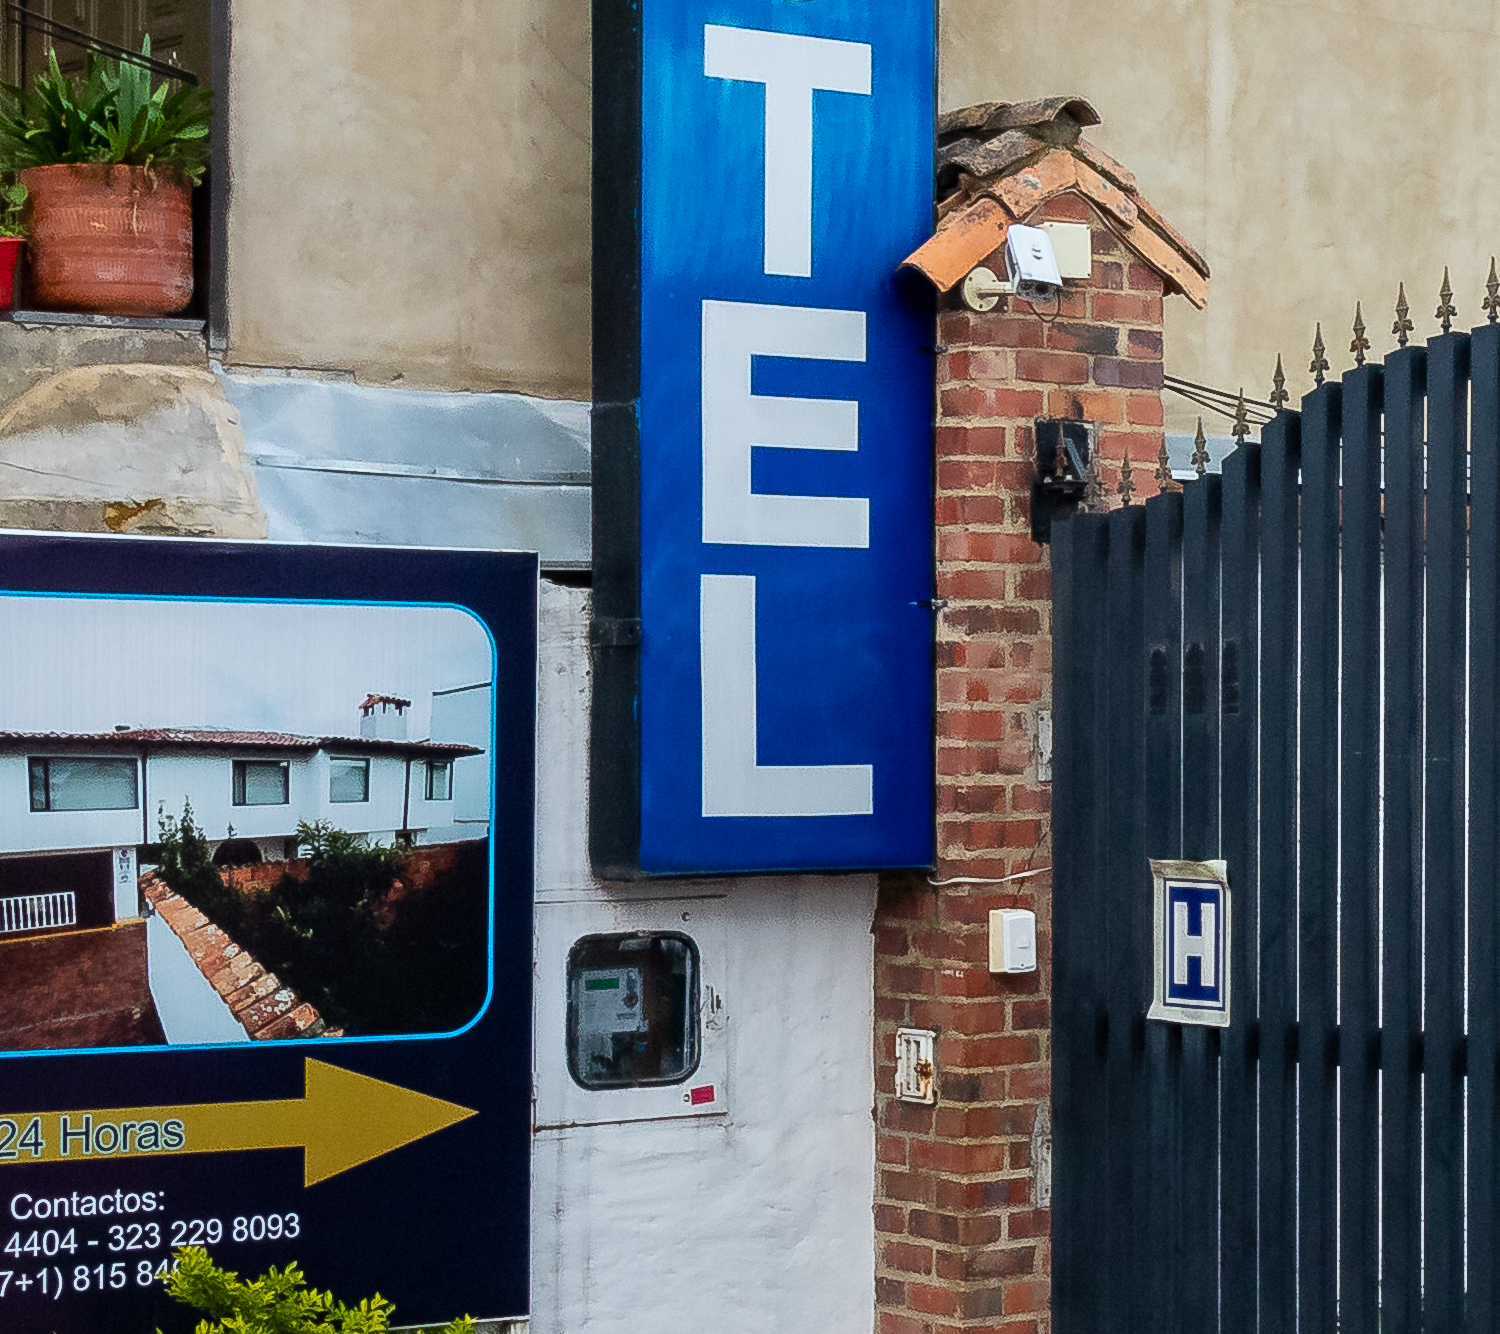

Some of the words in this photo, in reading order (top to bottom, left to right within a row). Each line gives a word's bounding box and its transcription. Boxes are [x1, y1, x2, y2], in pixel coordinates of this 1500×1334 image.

[1173, 901, 1216, 987] H
[60, 1114, 185, 1156] Horas
[10, 1188, 166, 1220] Contactos:
[3, 1228, 78, 1258] 4404
[108, 1222, 162, 1251] 323
[170, 1218, 223, 1247] 229
[232, 1213, 300, 1243] 8093
[73, 1262, 126, 1292] 815
